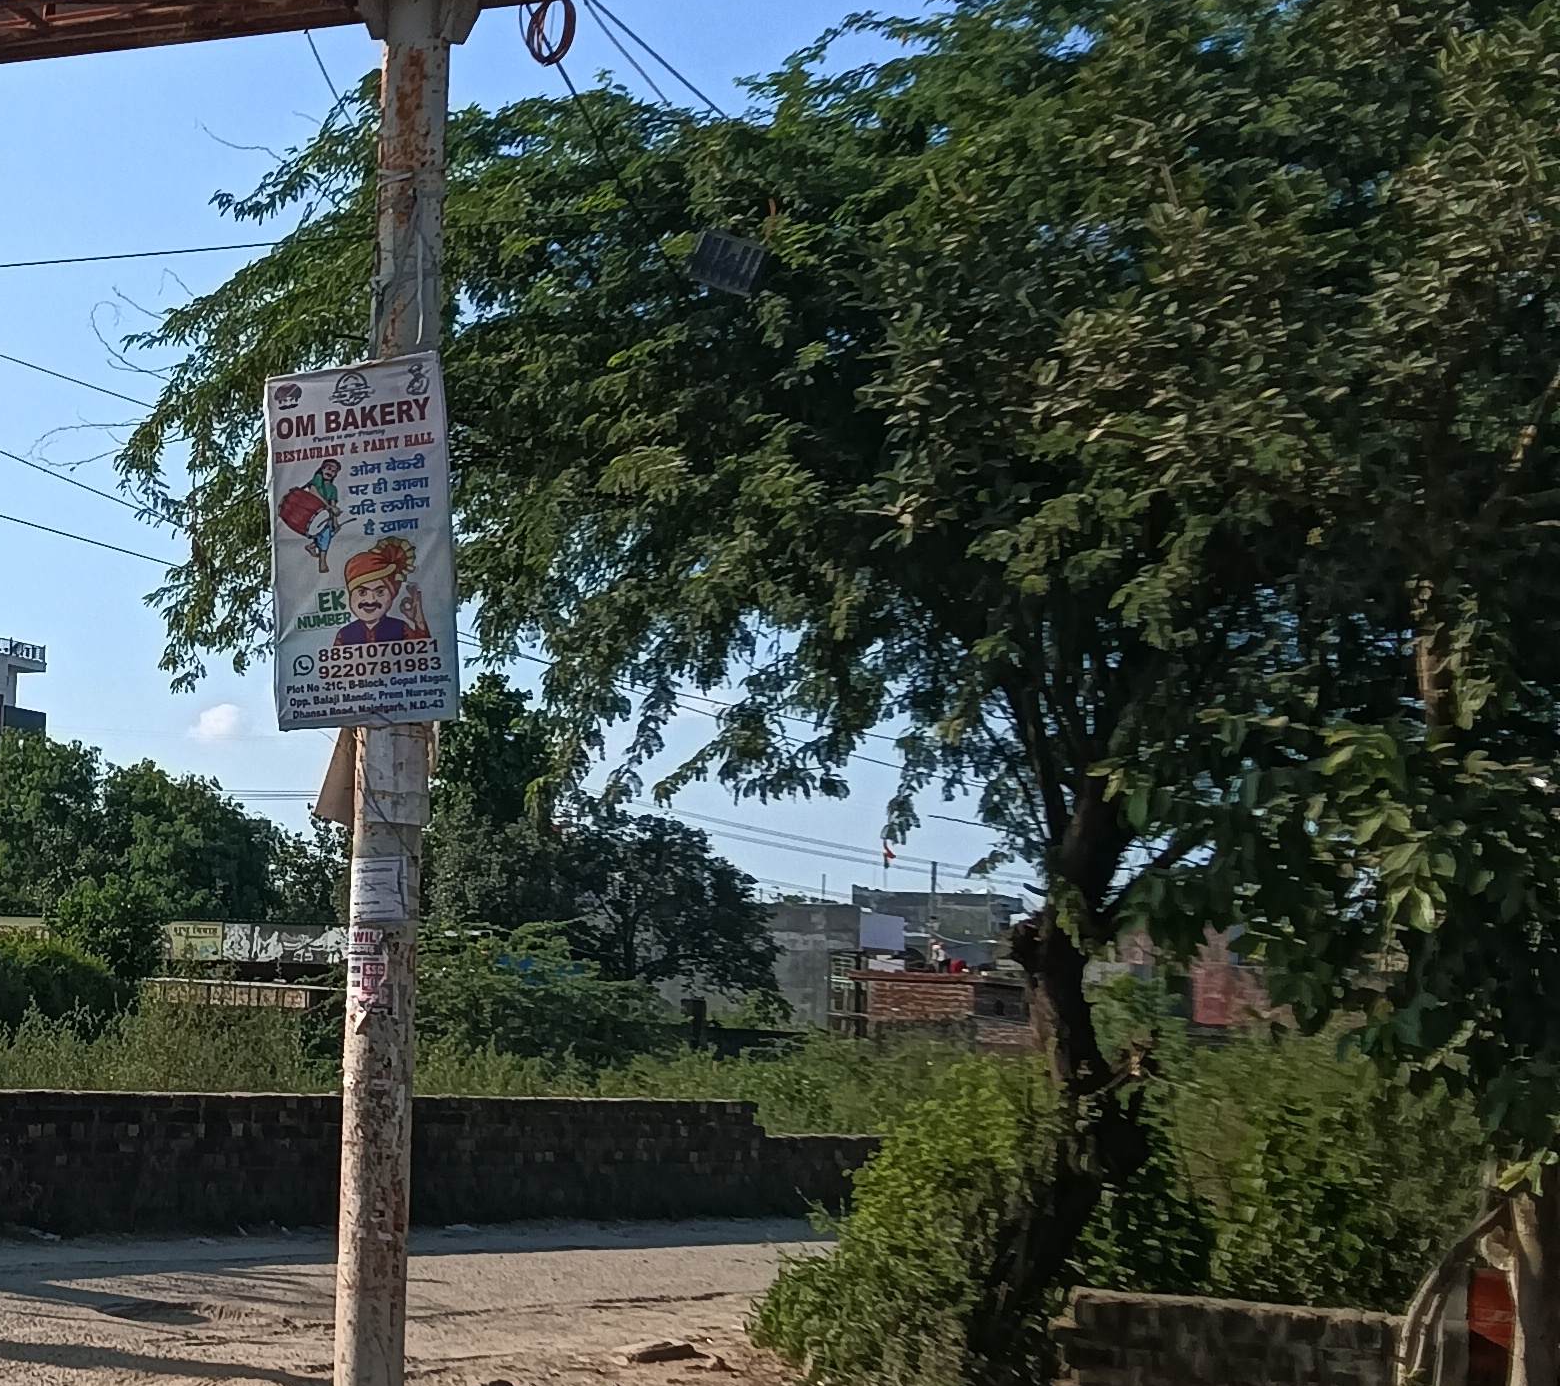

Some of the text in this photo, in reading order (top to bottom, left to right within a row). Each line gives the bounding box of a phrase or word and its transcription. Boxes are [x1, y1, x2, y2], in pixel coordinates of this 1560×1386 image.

[276, 413, 316, 440] OM
[324, 396, 430, 434] BAKERY
[274, 431, 435, 464] RESTAURANT & PARTY HALL
[349, 460, 382, 477] ओम
[347, 476, 430, 496] पर ही आना
[348, 493, 431, 516] यदि लजीज
[362, 517, 420, 536] है खाना
[317, 590, 347, 612] EK
[296, 611, 352, 630] NUMBER
[318, 639, 439, 663] 8851070021
[318, 656, 442, 680] 9220781983
[286, 683, 305, 695] Plot
[306, 682, 320, 693] No
[348, 678, 388, 690] B-Block,
[389, 675, 418, 688] Gopal
[419, 673, 452, 686] Nagar,
[289, 686, 447, 709] Opp. Balaji Mandir, Prem Nursery,
[292, 706, 328, 720] Dhansa
[329, 704, 357, 717] Road,
